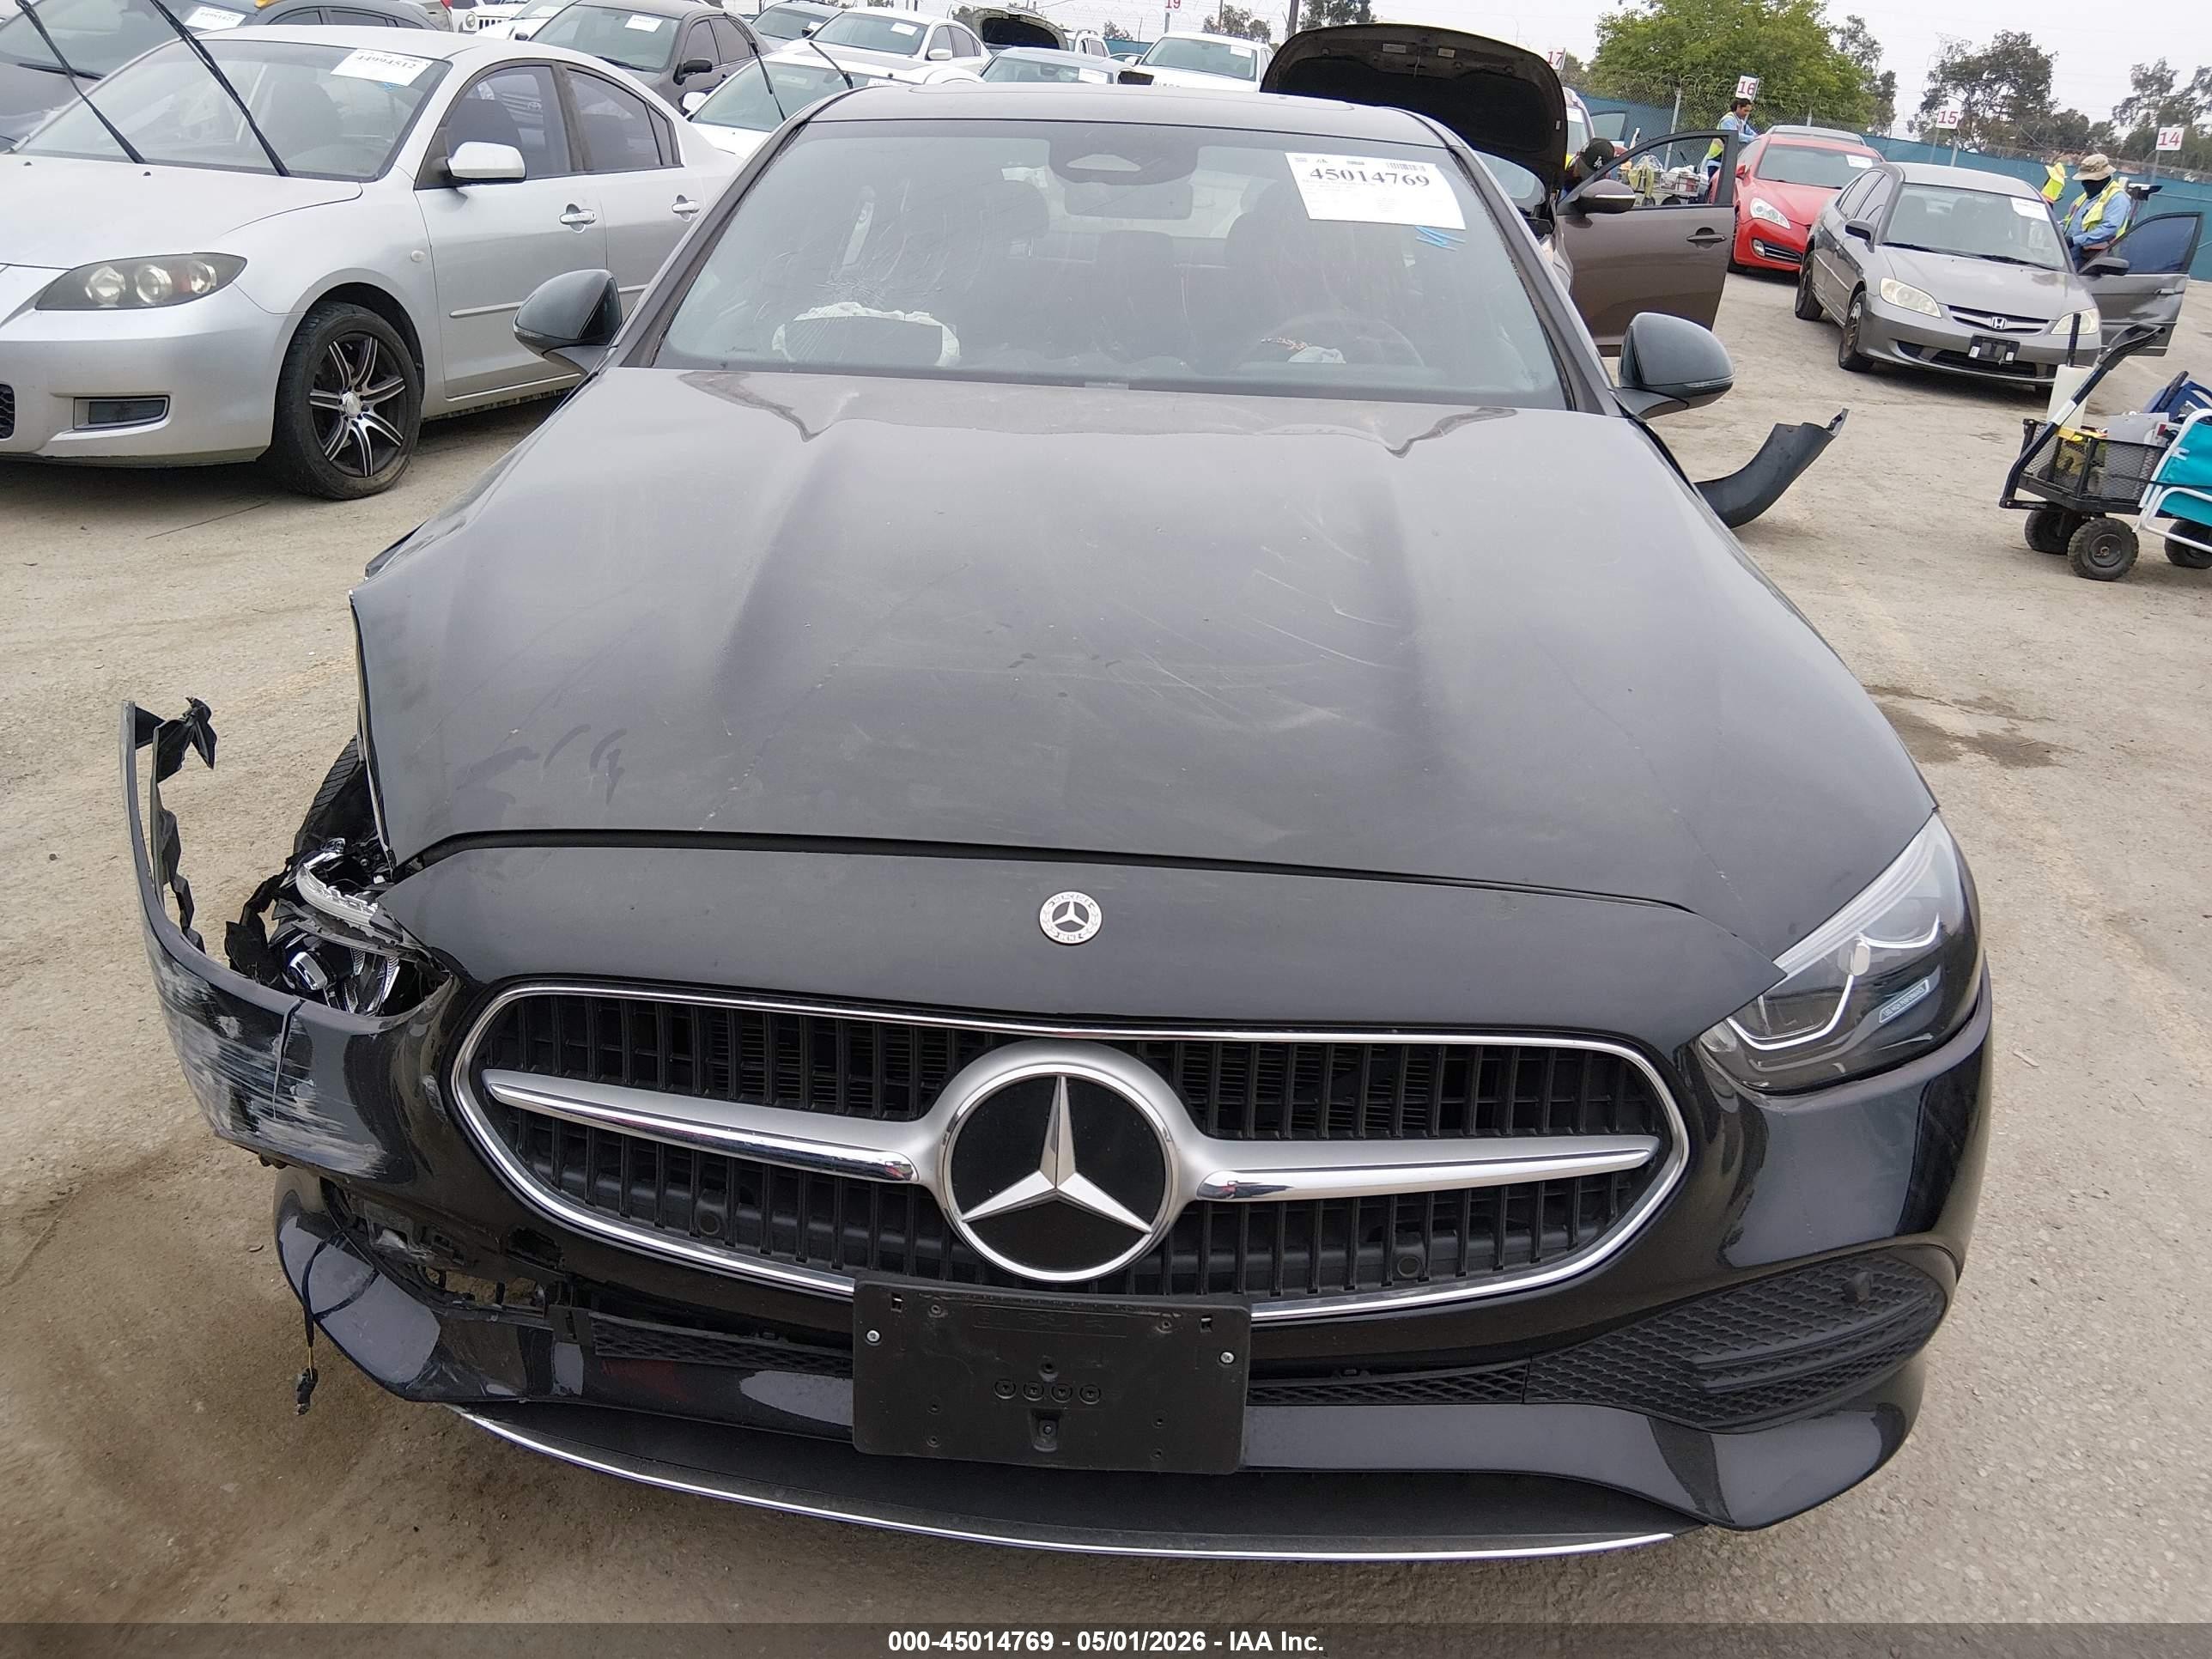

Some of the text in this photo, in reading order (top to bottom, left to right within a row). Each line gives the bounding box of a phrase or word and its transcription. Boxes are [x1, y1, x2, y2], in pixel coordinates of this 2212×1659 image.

[1165, 0, 1181, 9] 19
[1547, 51, 1564, 65] 17
[1738, 81, 1755, 95] 16
[1938, 111, 1958, 125] 15
[2158, 131, 2180, 146] 14
[1310, 167, 1430, 187] 45014769
